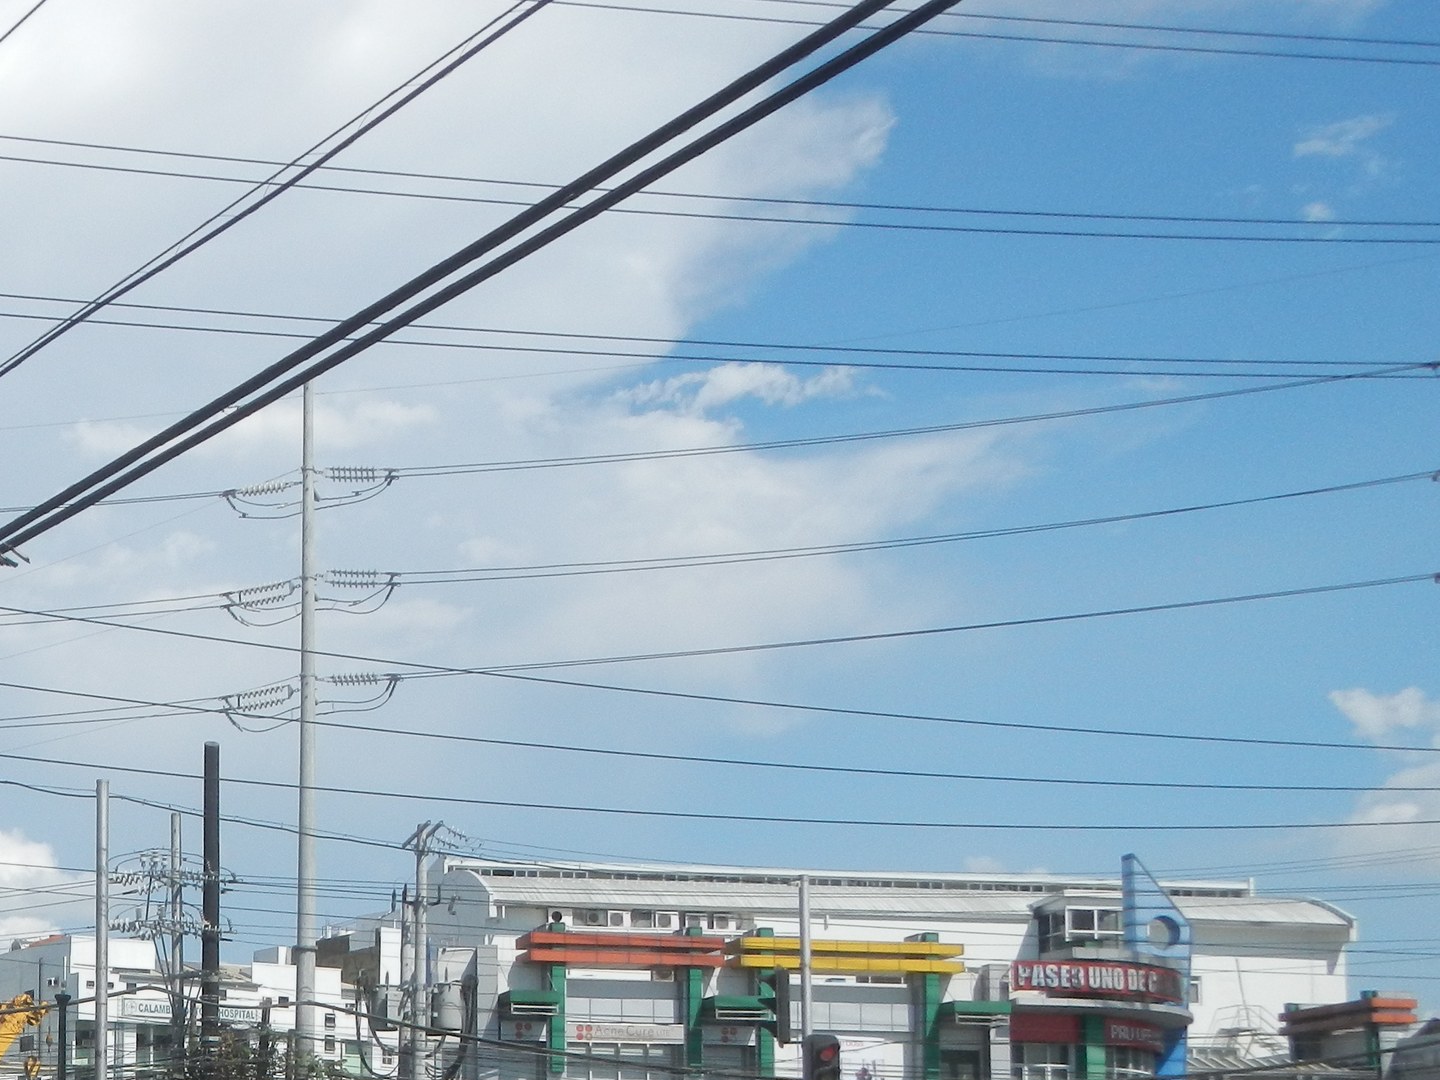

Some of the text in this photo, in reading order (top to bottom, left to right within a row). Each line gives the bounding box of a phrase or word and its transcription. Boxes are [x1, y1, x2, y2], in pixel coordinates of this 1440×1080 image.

[1018, 963, 1085, 988] PASEO
[1088, 966, 1125, 990] UNO
[1127, 968, 1146, 992] DE
[138, 1002, 171, 1014] CALAMB
[218, 1008, 255, 1020] HOSPITAL
